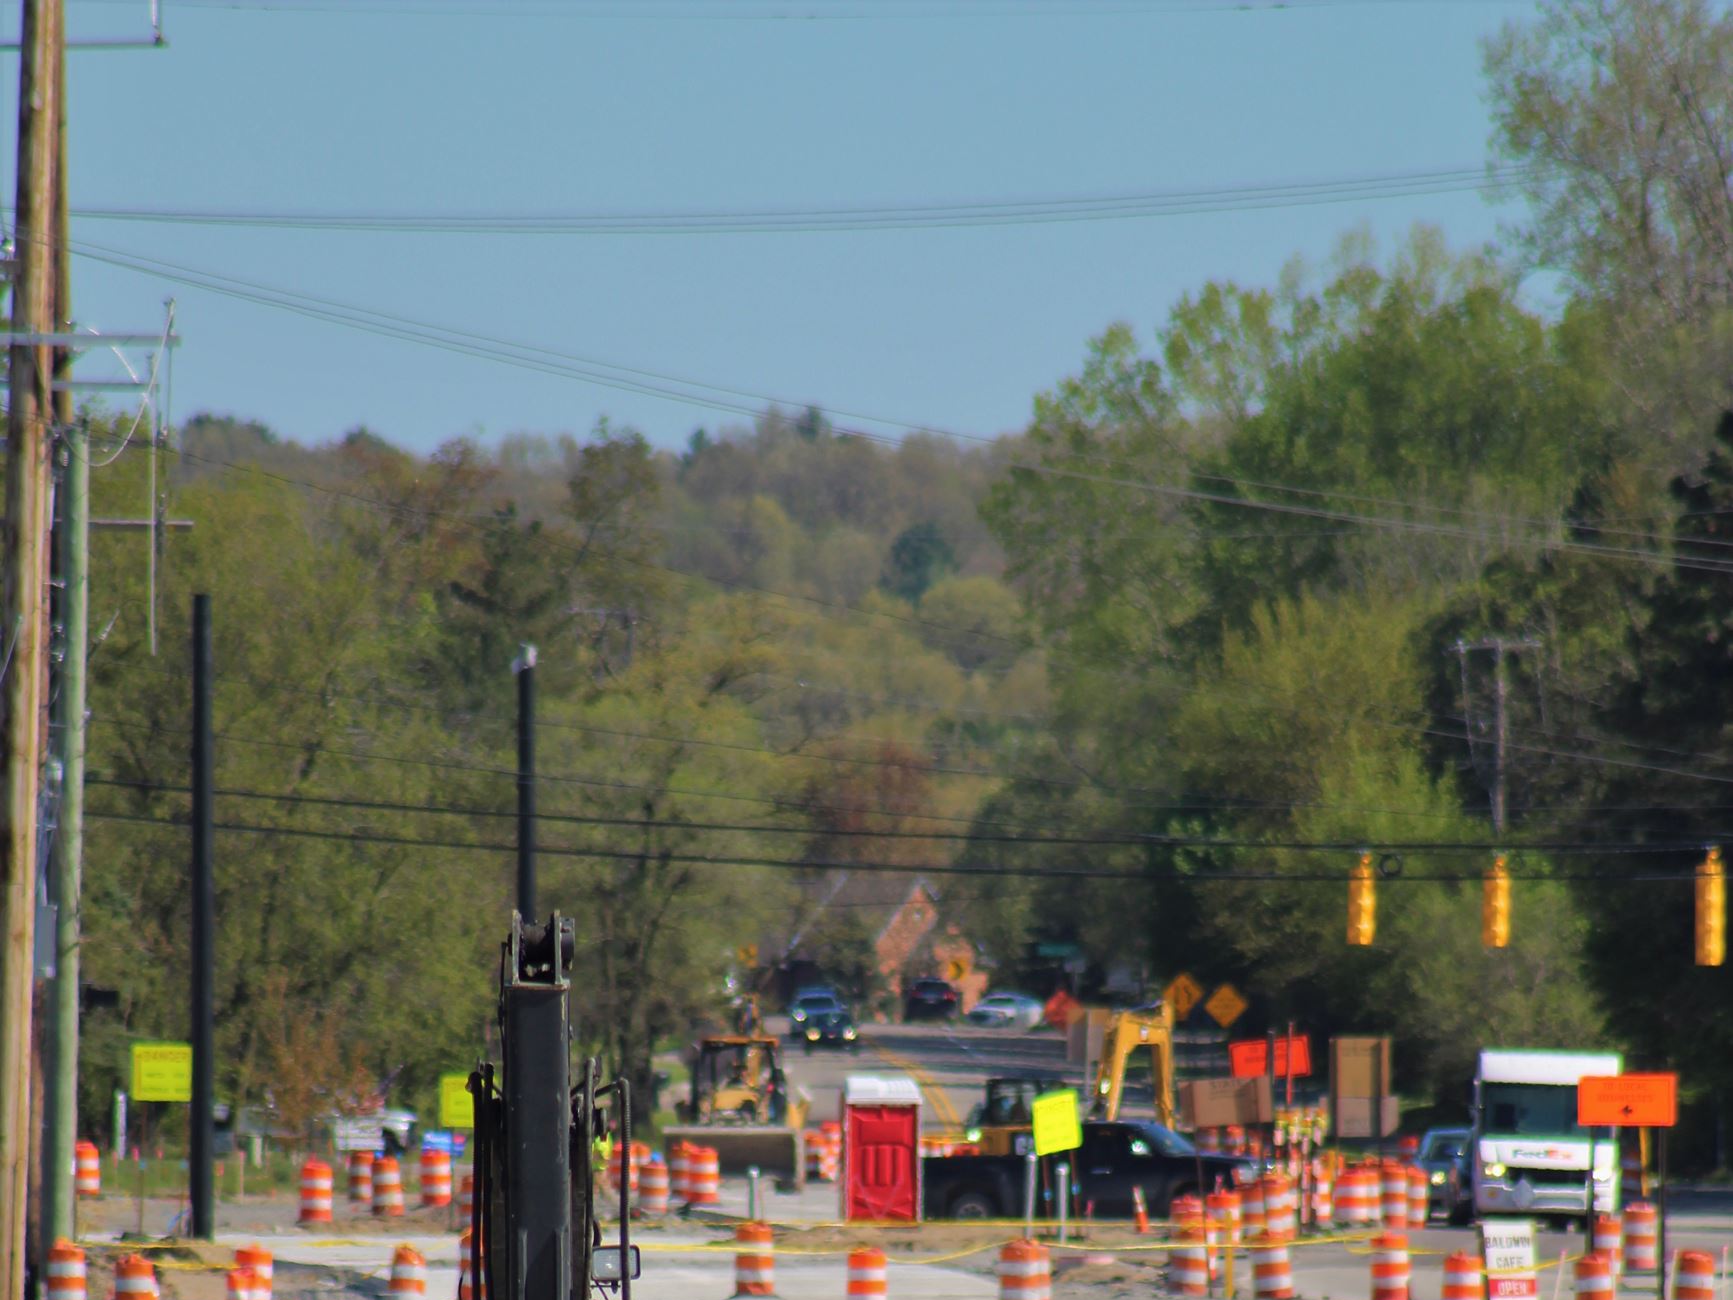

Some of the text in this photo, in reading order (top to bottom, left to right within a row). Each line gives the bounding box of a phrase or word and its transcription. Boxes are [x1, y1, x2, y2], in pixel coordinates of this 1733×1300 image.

[1484, 1236, 1532, 1249] BALDWIN
[1495, 1255, 1524, 1269] CAFE
[1497, 1279, 1528, 1296] OPEN
